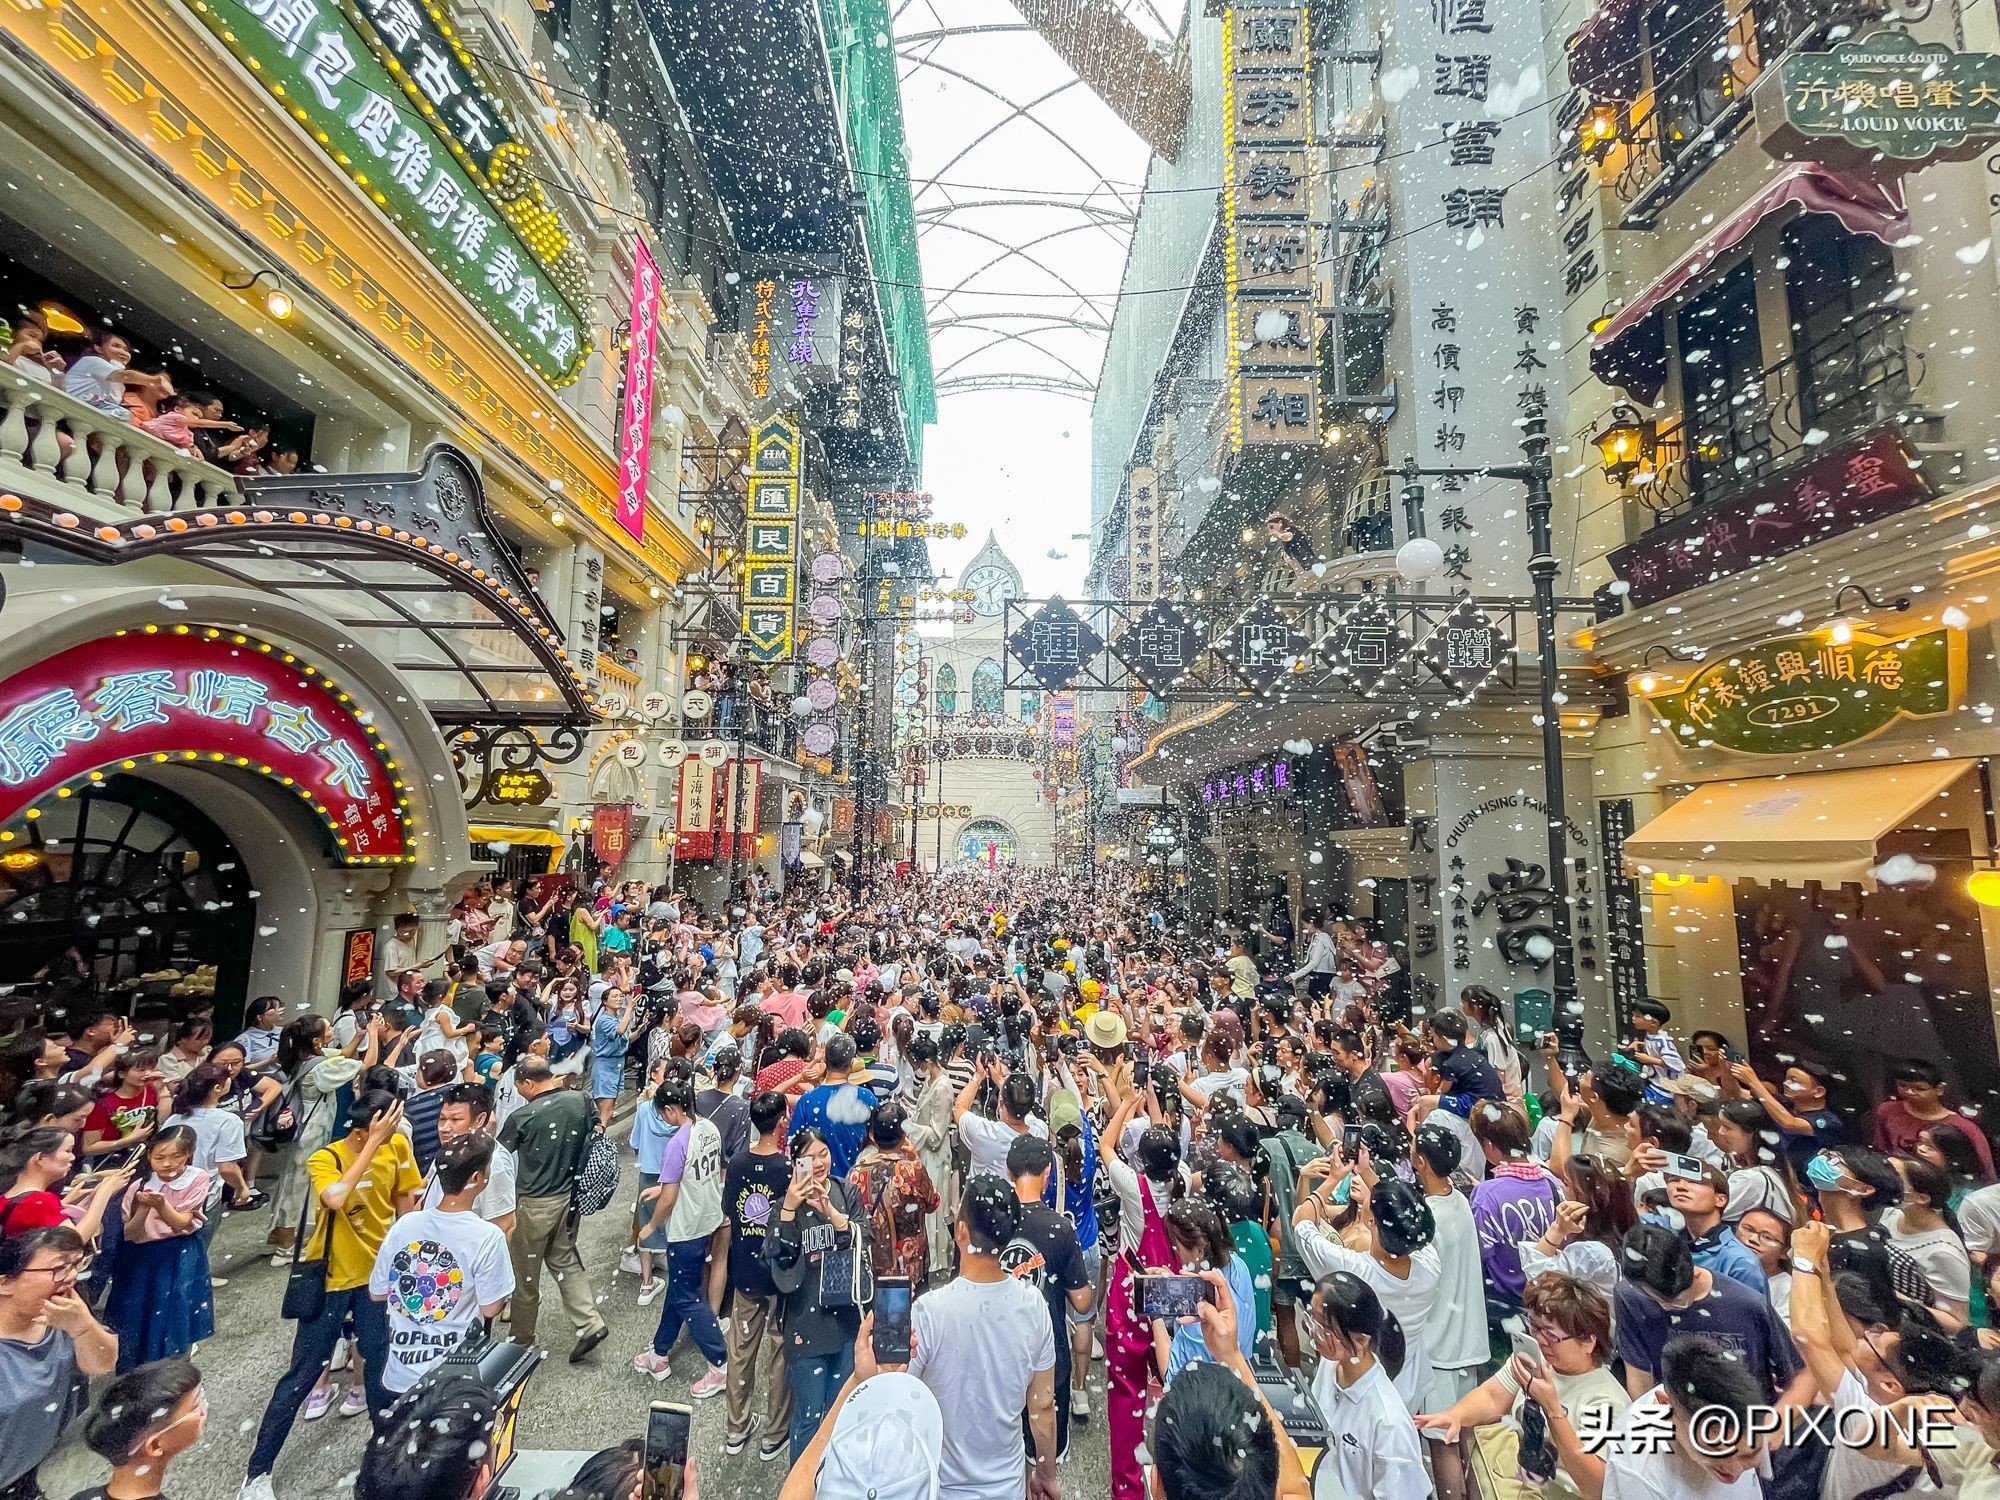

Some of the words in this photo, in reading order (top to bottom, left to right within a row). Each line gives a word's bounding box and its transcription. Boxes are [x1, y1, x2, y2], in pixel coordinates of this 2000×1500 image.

[1840, 53, 1871, 66] LOUD
[1873, 53, 1907, 64] VOICE
[1840, 117, 1899, 131] LOUD
[1903, 117, 1967, 131] VOICE
[762, 449, 786, 460] HM
[1767, 702, 1821, 722] 7291
[689, 763, 704, 827] 上海味道
[1446, 809, 1479, 848] CHUEN
[1478, 795, 1518, 815] HSING
[1522, 797, 1548, 815] PAW
[602, 827, 624, 850] 酒
[750, 1183, 775, 1200] YORK
[741, 1226, 767, 1238] YANKE
[1012, 1252, 1046, 1280] FINE
